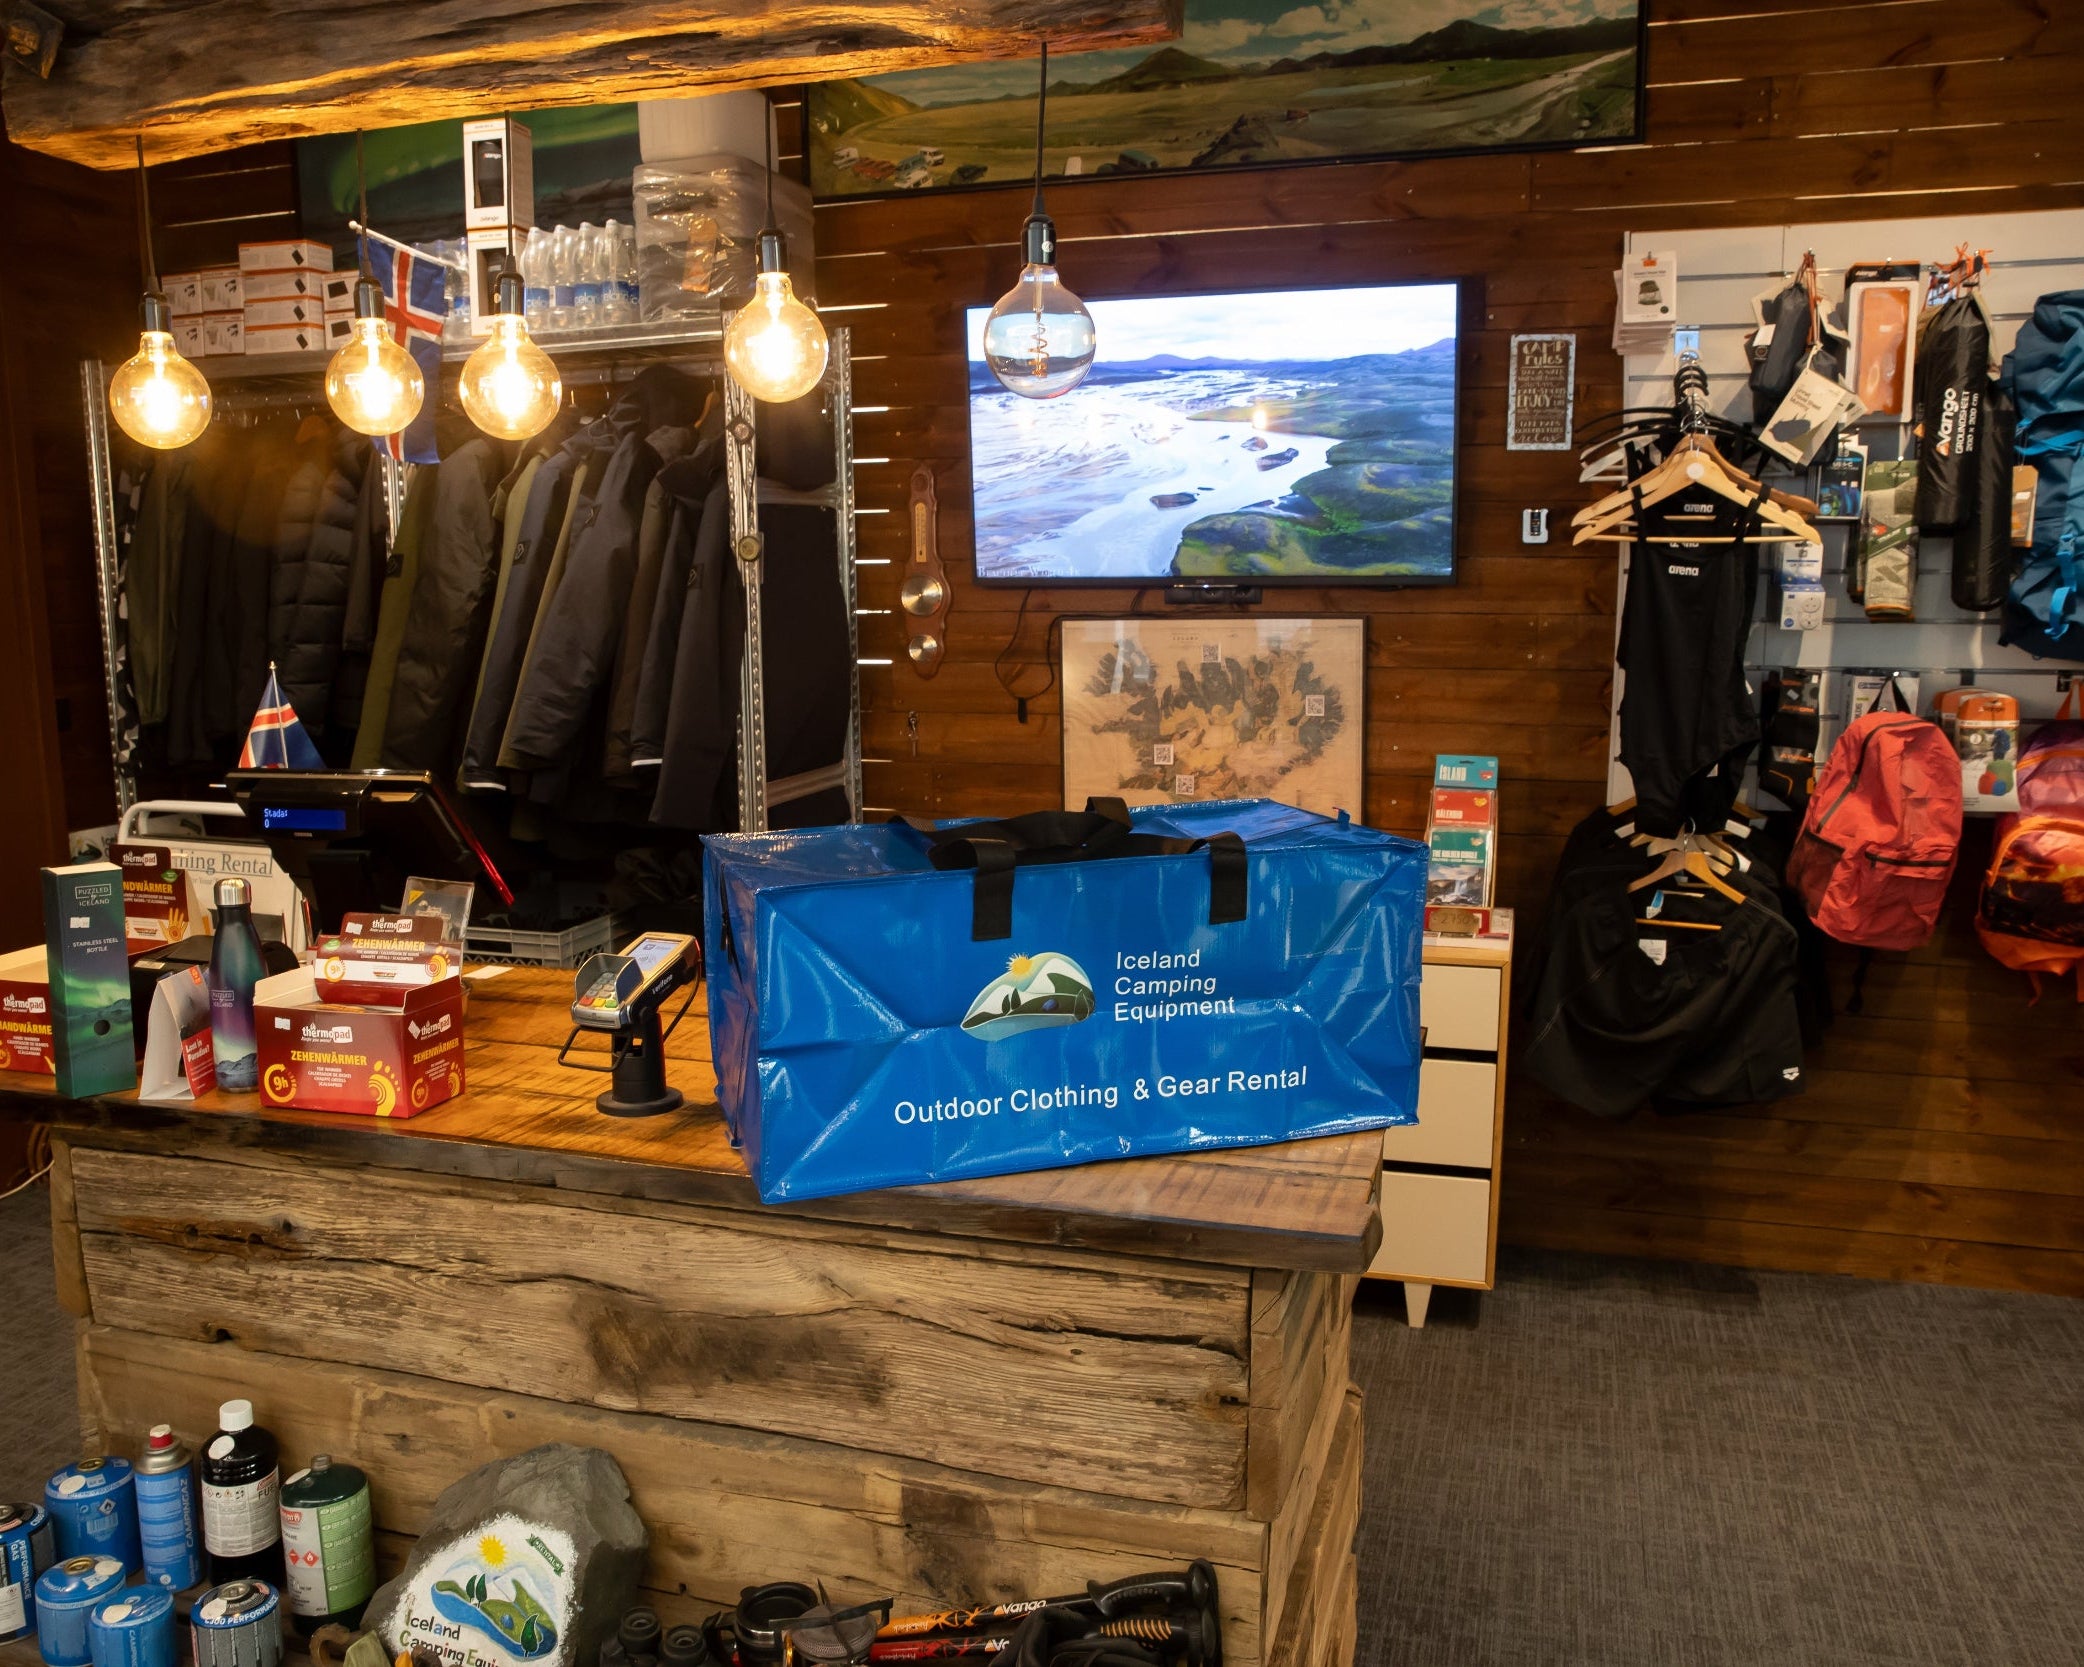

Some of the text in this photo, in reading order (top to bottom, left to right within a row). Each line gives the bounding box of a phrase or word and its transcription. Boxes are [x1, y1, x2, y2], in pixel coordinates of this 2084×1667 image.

[1936, 388, 1959, 450] Vango
[1955, 391, 1970, 454] GROUNDSHEET
[1684, 504, 1714, 513] arena
[1668, 565, 1699, 576] arena
[122, 852, 157, 867] thermopad
[222, 853, 273, 875] Rental
[80, 898, 110, 906] ICELAND
[372, 919, 413, 933] thermopad
[352, 938, 425, 951] ZEHENWÄRMER
[1116, 949, 1200, 970] Iceland
[1115, 975, 1217, 997] Camping
[3, 996, 46, 1013] thermopad
[1114, 997, 1236, 1023] Equipment
[301, 1024, 353, 1043] thermopad
[421, 1014, 451, 1035] thermopad
[291, 1050, 367, 1066] ZEHENWÄRMER
[413, 1038, 459, 1065] ZEHENWÄRMER
[273, 1076, 289, 1091] 9h
[894, 1066, 1308, 1125] Outdoor Clothing & Gear Rental
[180, 1479, 193, 1548] CAMPINGAZ
[10, 1543, 20, 1561] GAS
[537, 1543, 558, 1567] RENTAL
[19, 1540, 32, 1600] PERFORMANCE
[227, 1595, 279, 1624] PERFORMANCE
[1002, 1599, 1047, 1615] Vango
[404, 1609, 461, 1641] Iceland
